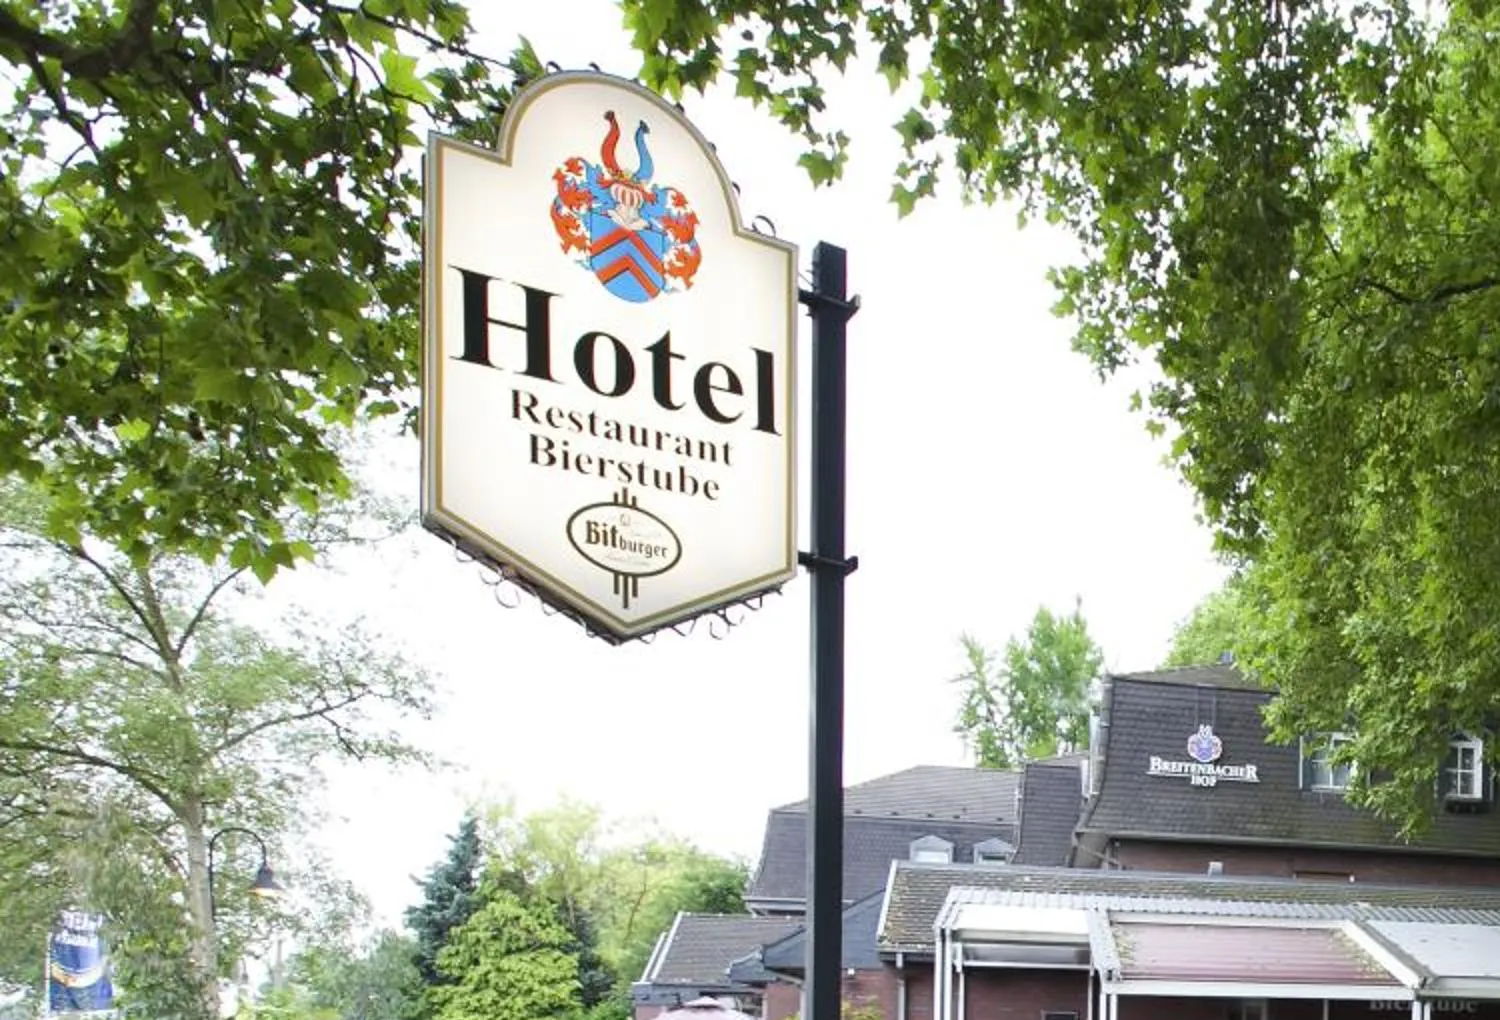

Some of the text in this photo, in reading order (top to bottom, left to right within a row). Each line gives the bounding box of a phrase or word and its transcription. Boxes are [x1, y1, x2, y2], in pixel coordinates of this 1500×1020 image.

[448, 264, 783, 437] Hotel
[511, 388, 734, 467] Restaurant
[529, 433, 721, 501] Bierstube
[585, 519, 668, 559] Bitburger
[1149, 756, 1258, 780] BREITENBACHER
[1191, 775, 1217, 787] HOF
